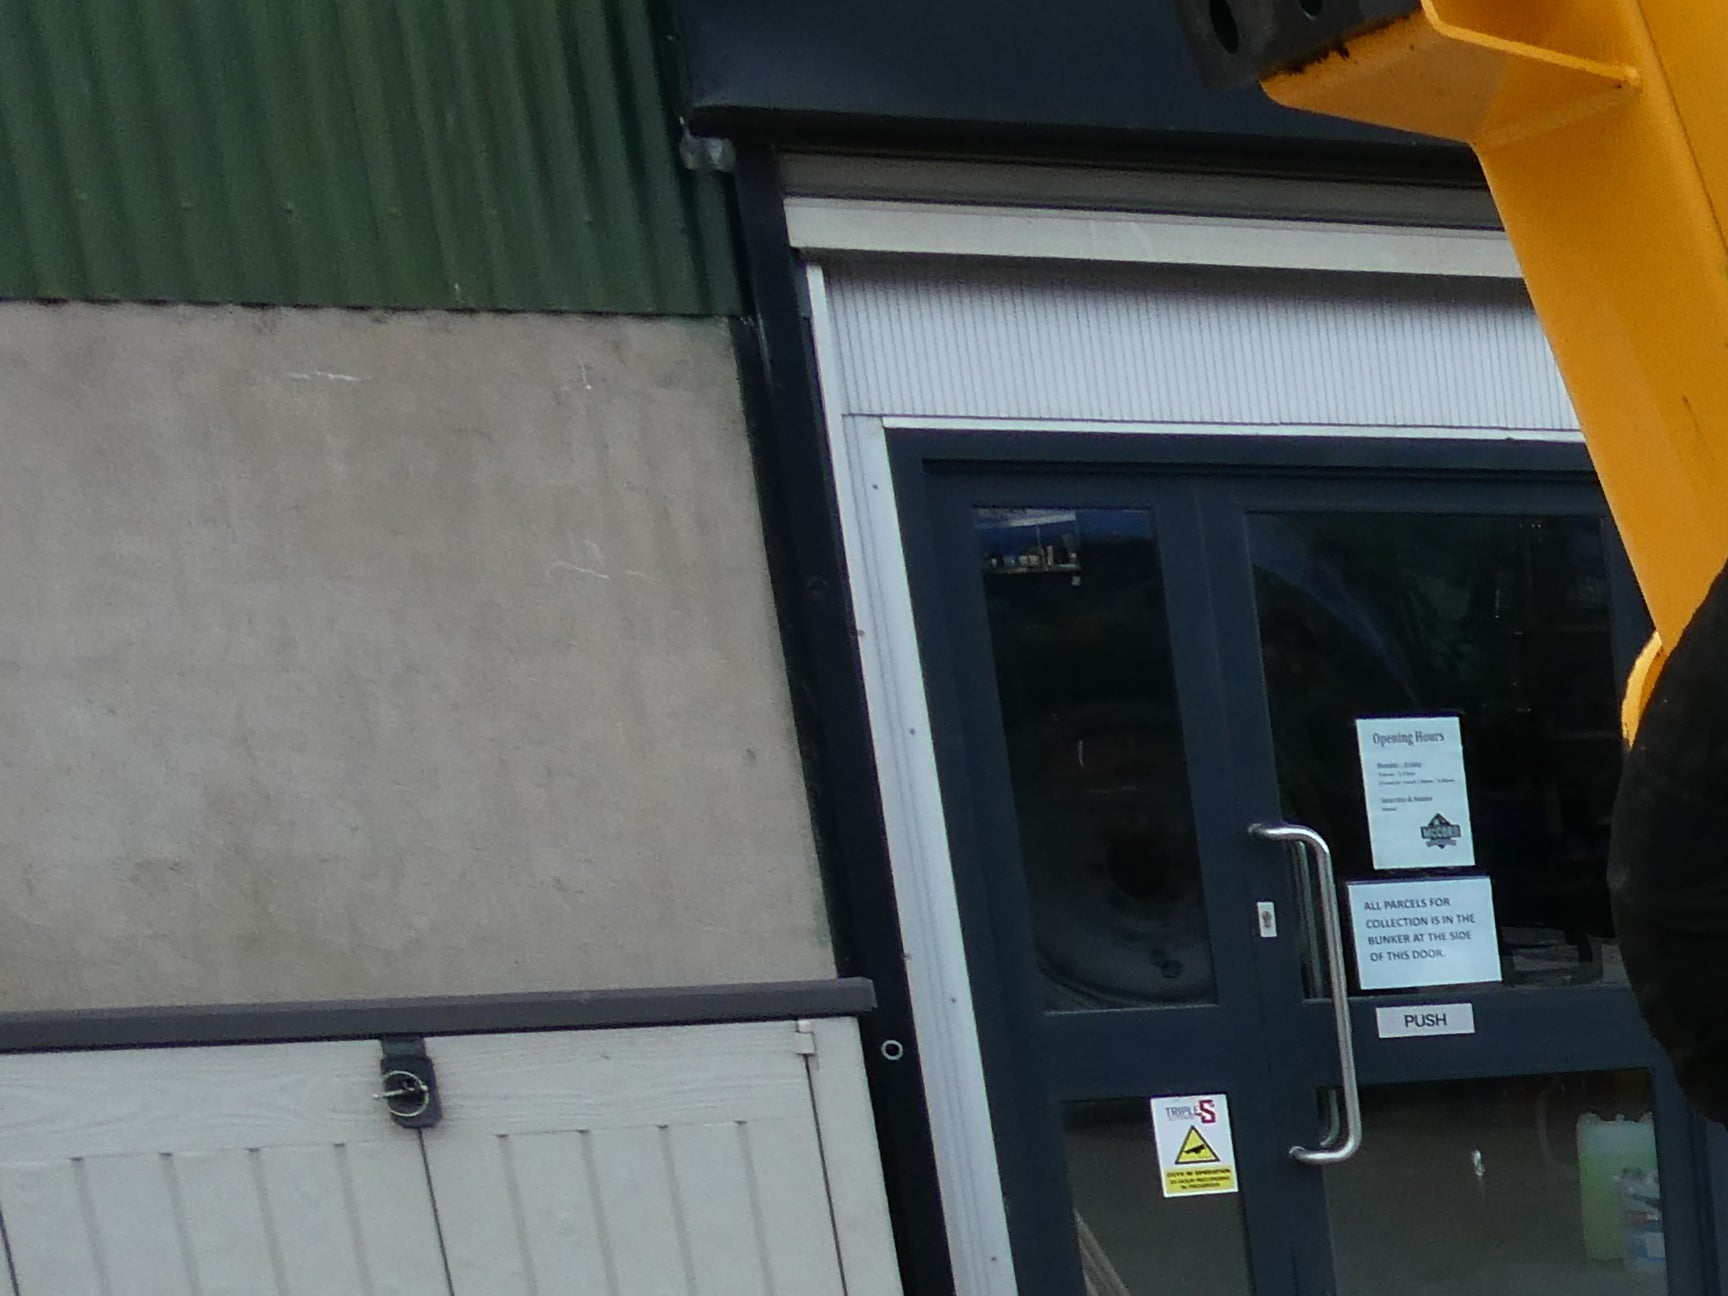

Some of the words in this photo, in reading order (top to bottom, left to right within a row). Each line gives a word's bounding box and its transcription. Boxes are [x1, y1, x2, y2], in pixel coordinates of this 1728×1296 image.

[1373, 732, 1413, 747] Opening
[1415, 730, 1445, 743] Hours
[1364, 901, 1381, 910] ALL
[1384, 899, 1427, 909] PARCELS
[1430, 897, 1450, 907] FOR
[1366, 917, 1428, 929] COLLECTION
[1431, 915, 1440, 925] IS
[1443, 915, 1454, 924] IN
[1456, 913, 1475, 923] THE
[1368, 934, 1410, 945] BUNKER
[1413, 933, 1425, 943] AT
[1427, 932, 1447, 942] THE
[1449, 930, 1472, 940] SIDE
[1370, 952, 1384, 962] OF
[1387, 950, 1410, 961] THIS
[1404, 1012, 1448, 1027] PUSH
